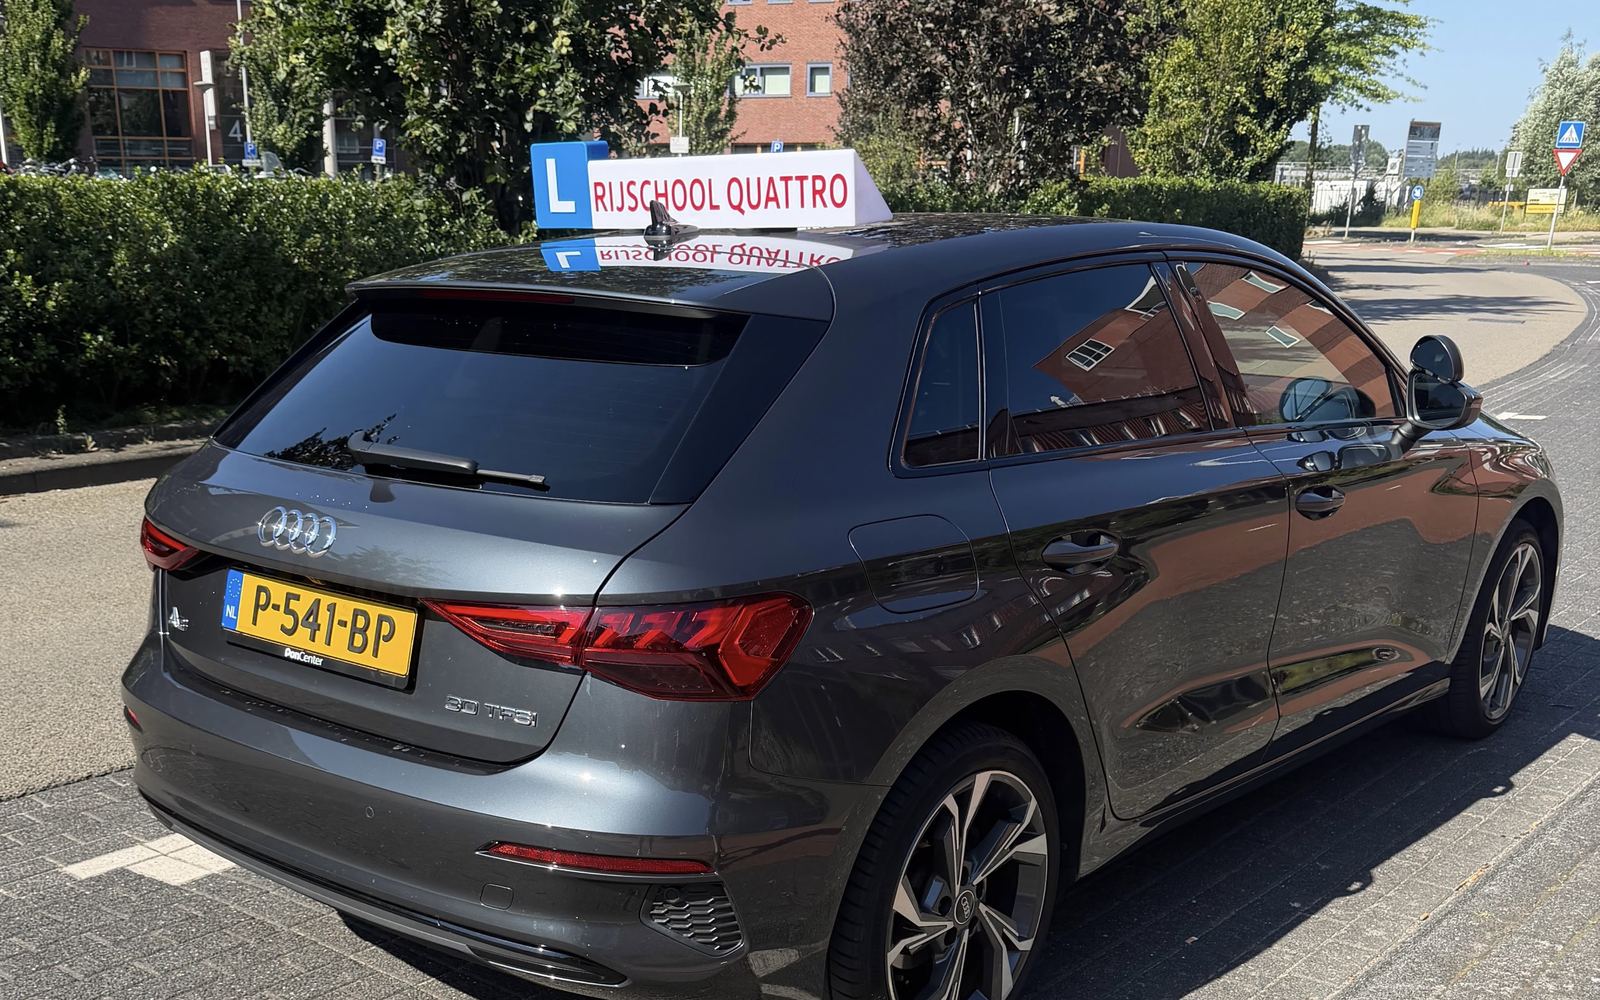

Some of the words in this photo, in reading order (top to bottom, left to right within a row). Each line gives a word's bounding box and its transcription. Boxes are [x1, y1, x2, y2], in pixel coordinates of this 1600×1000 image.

[228, 119, 243, 142] 4
[545, 158, 576, 213] L
[593, 178, 720, 212] RIJSCHOOL
[726, 173, 848, 216] QUATTRO
[225, 604, 237, 620] NL
[251, 585, 396, 659] P-541-BP
[284, 647, 324, 666] PonCenter
[444, 695, 479, 716] 30
[483, 702, 538, 728] TFSI
